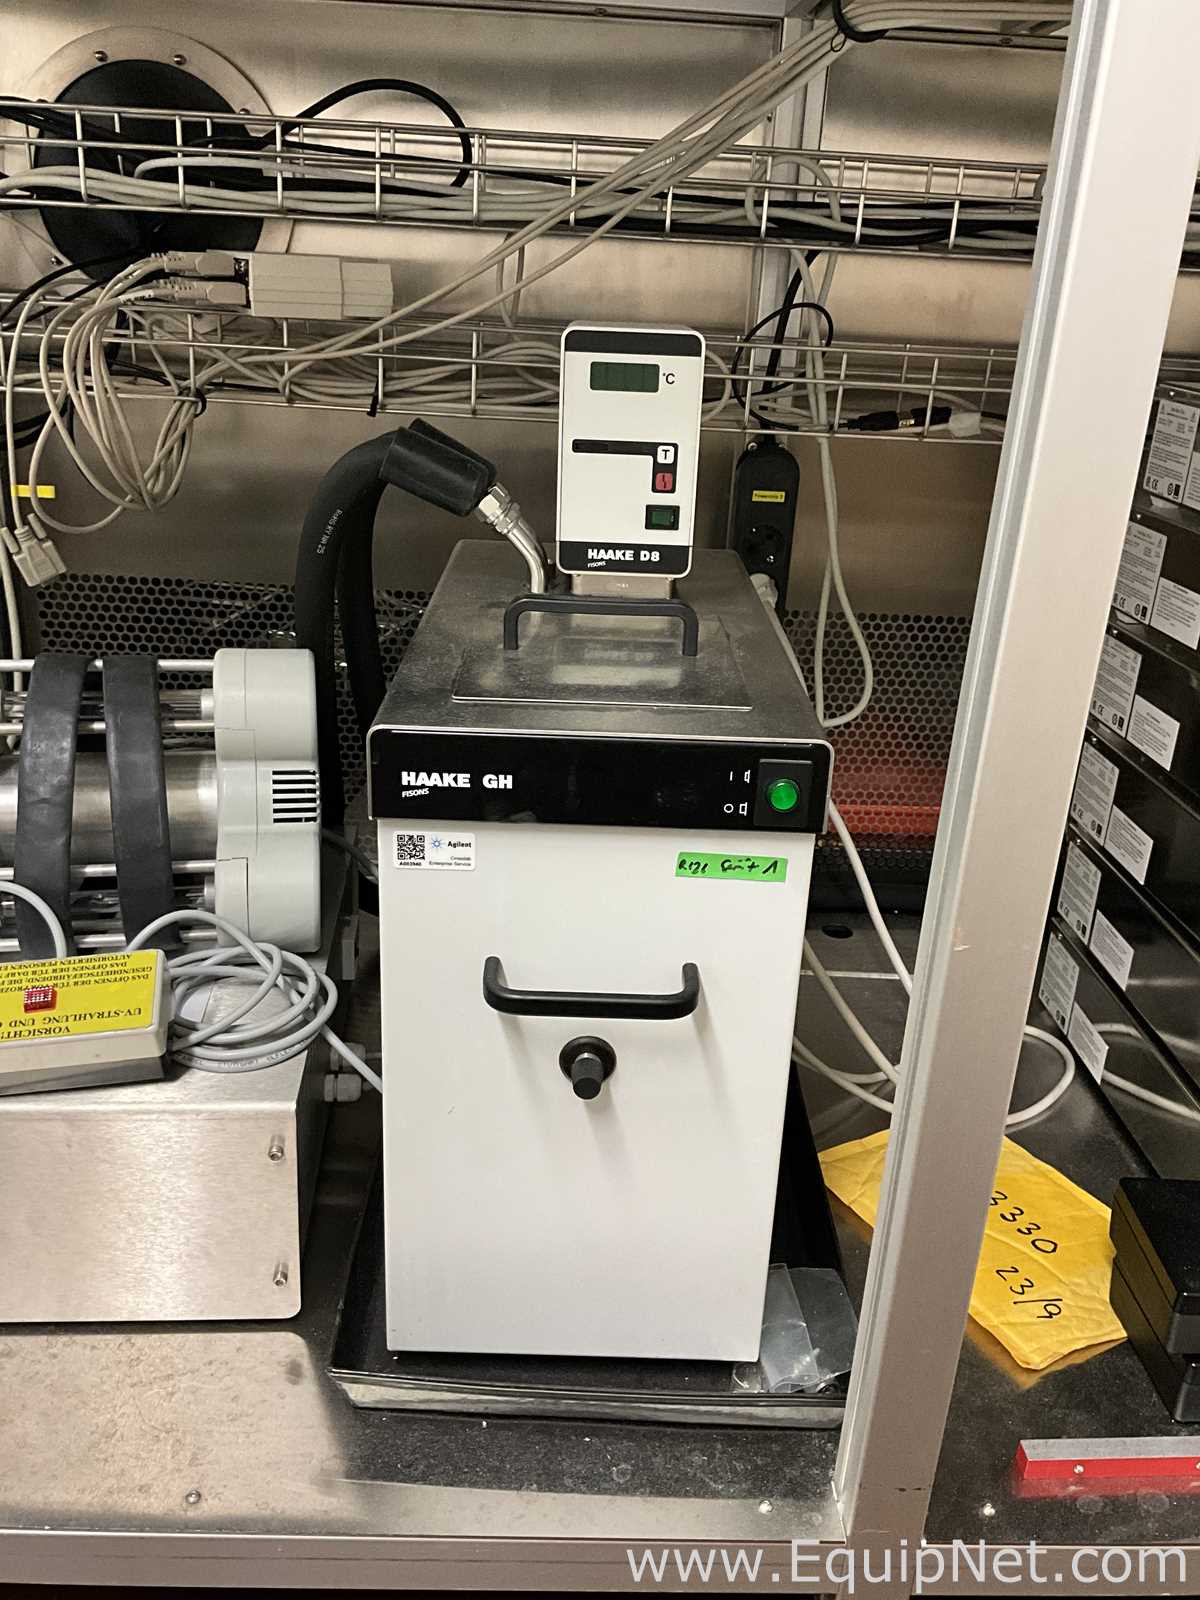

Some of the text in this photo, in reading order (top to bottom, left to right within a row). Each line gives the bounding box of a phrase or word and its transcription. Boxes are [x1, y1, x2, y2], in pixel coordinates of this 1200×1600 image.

[662, 372, 676, 385] °C
[661, 448, 671, 460] T
[587, 548, 660, 562] HAAKE D8
[401, 771, 513, 789] HAAKE GH
[401, 788, 430, 798] FISONS
[447, 841, 472, 849] Agilent
[42, 1007, 142, 1026] UV-STRAHLUNG
[9, 1018, 36, 1028] UND
